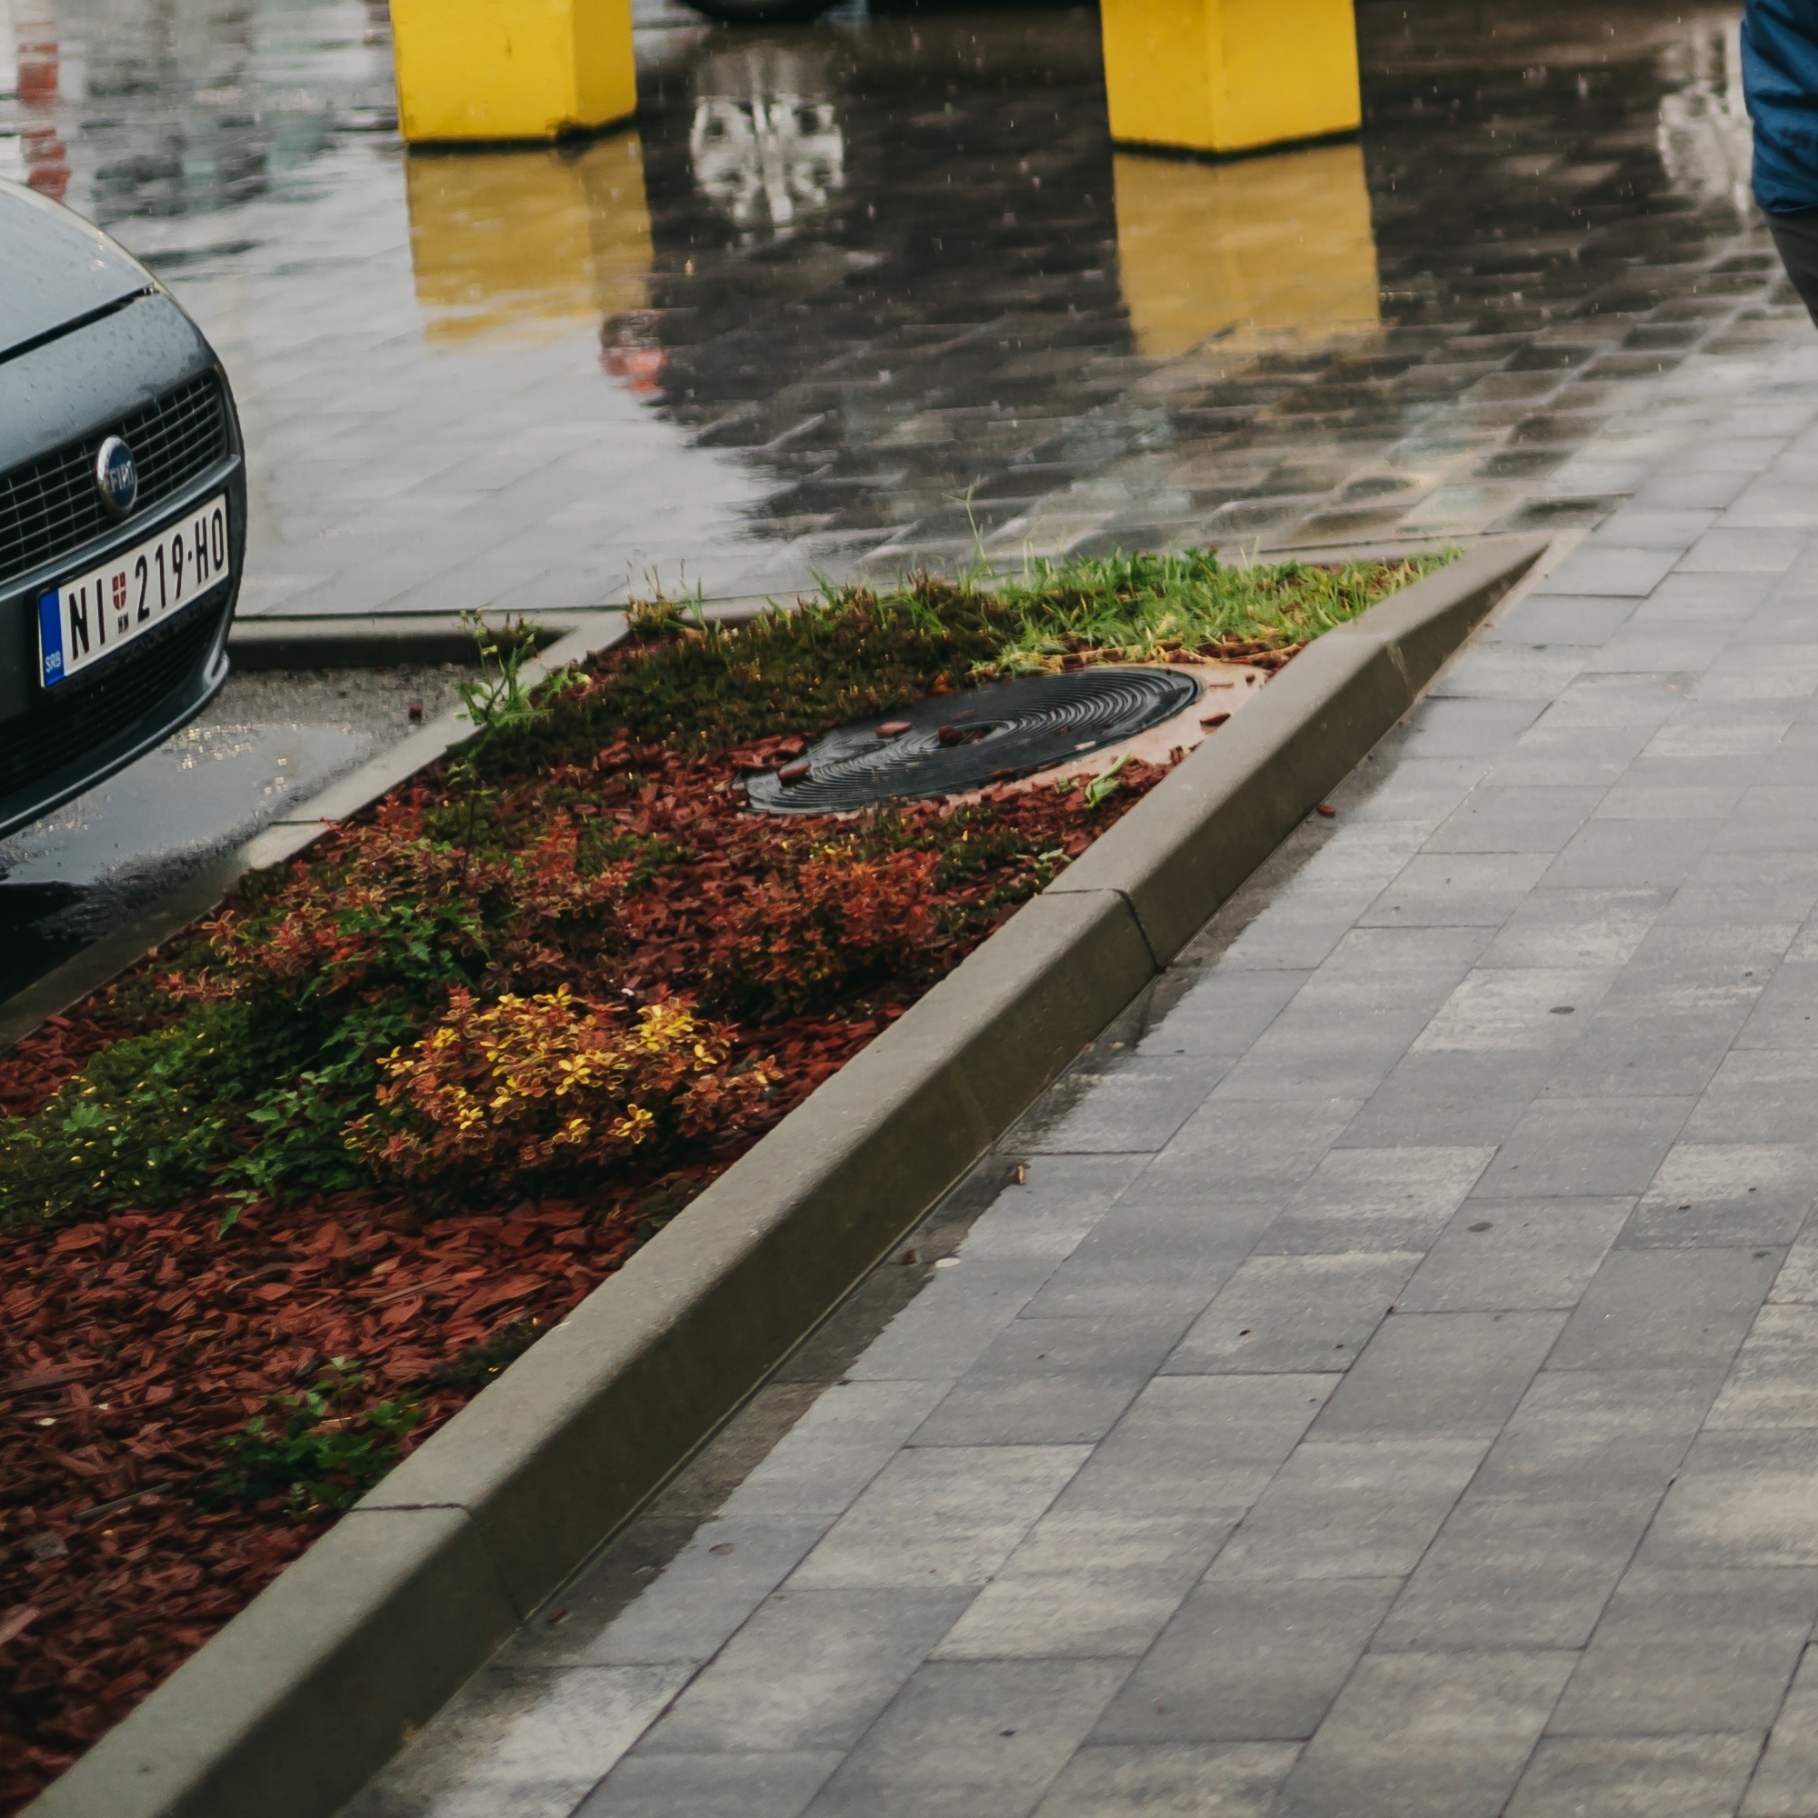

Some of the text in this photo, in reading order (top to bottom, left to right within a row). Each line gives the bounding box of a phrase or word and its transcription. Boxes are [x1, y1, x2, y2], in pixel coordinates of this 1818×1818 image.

[110, 460, 134, 492] FIAT
[68, 577, 105, 660] NI
[45, 650, 62, 673] SRB
